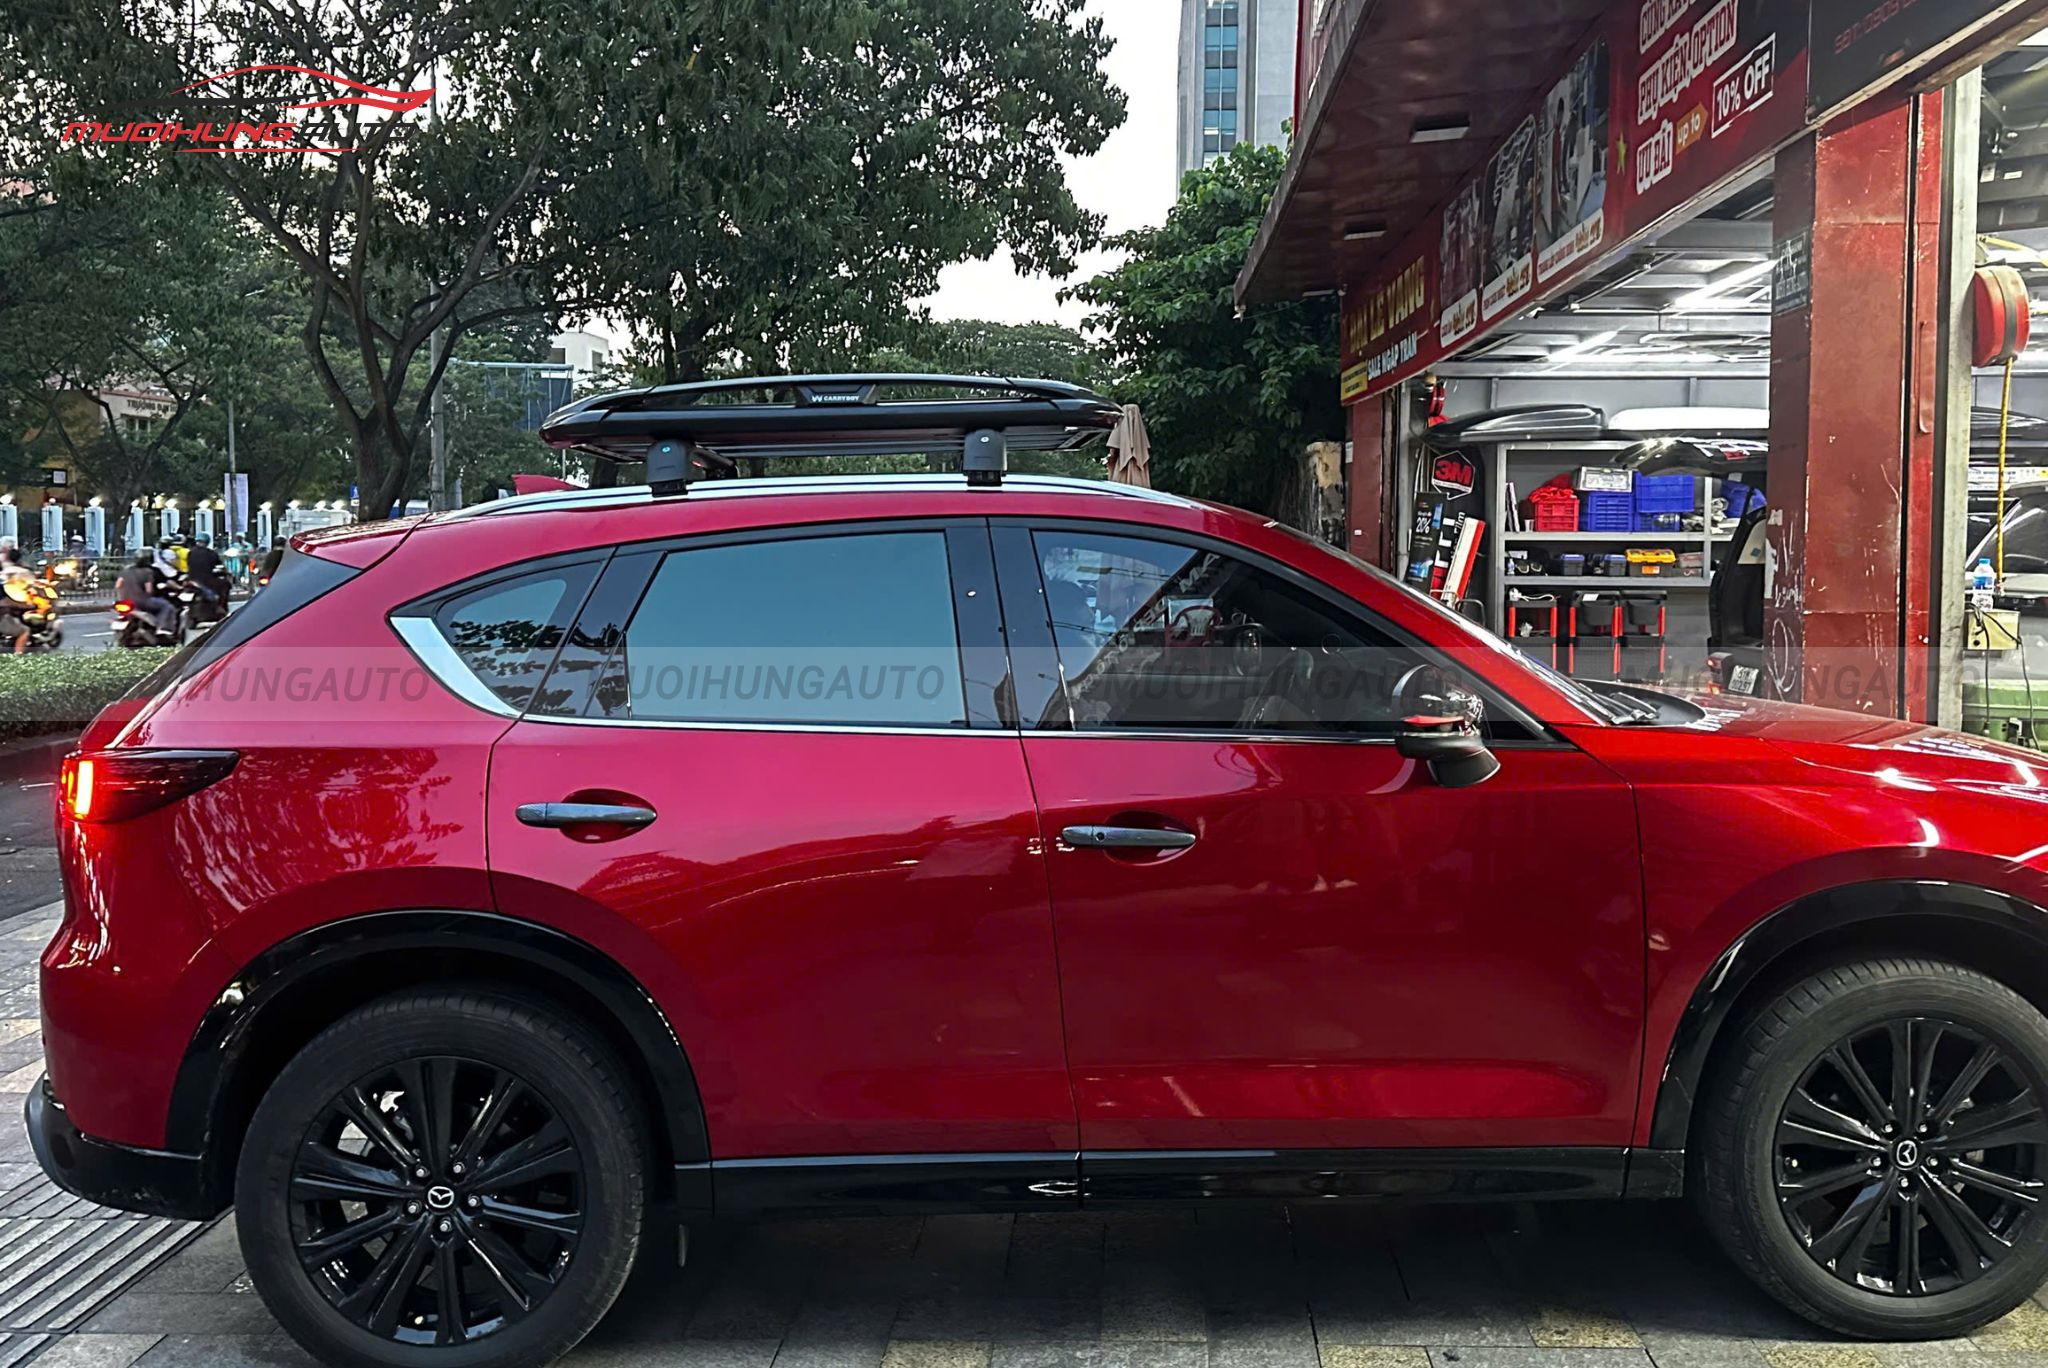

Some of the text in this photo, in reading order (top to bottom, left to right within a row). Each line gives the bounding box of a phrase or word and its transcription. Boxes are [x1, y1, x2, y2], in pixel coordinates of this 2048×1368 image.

[1692, 0, 1736, 75] OPTION
[1715, 50, 1771, 122] 10% OFF
[1677, 122, 1689, 146] up
[1690, 112, 1701, 134] to
[1435, 459, 1472, 486] 3M
